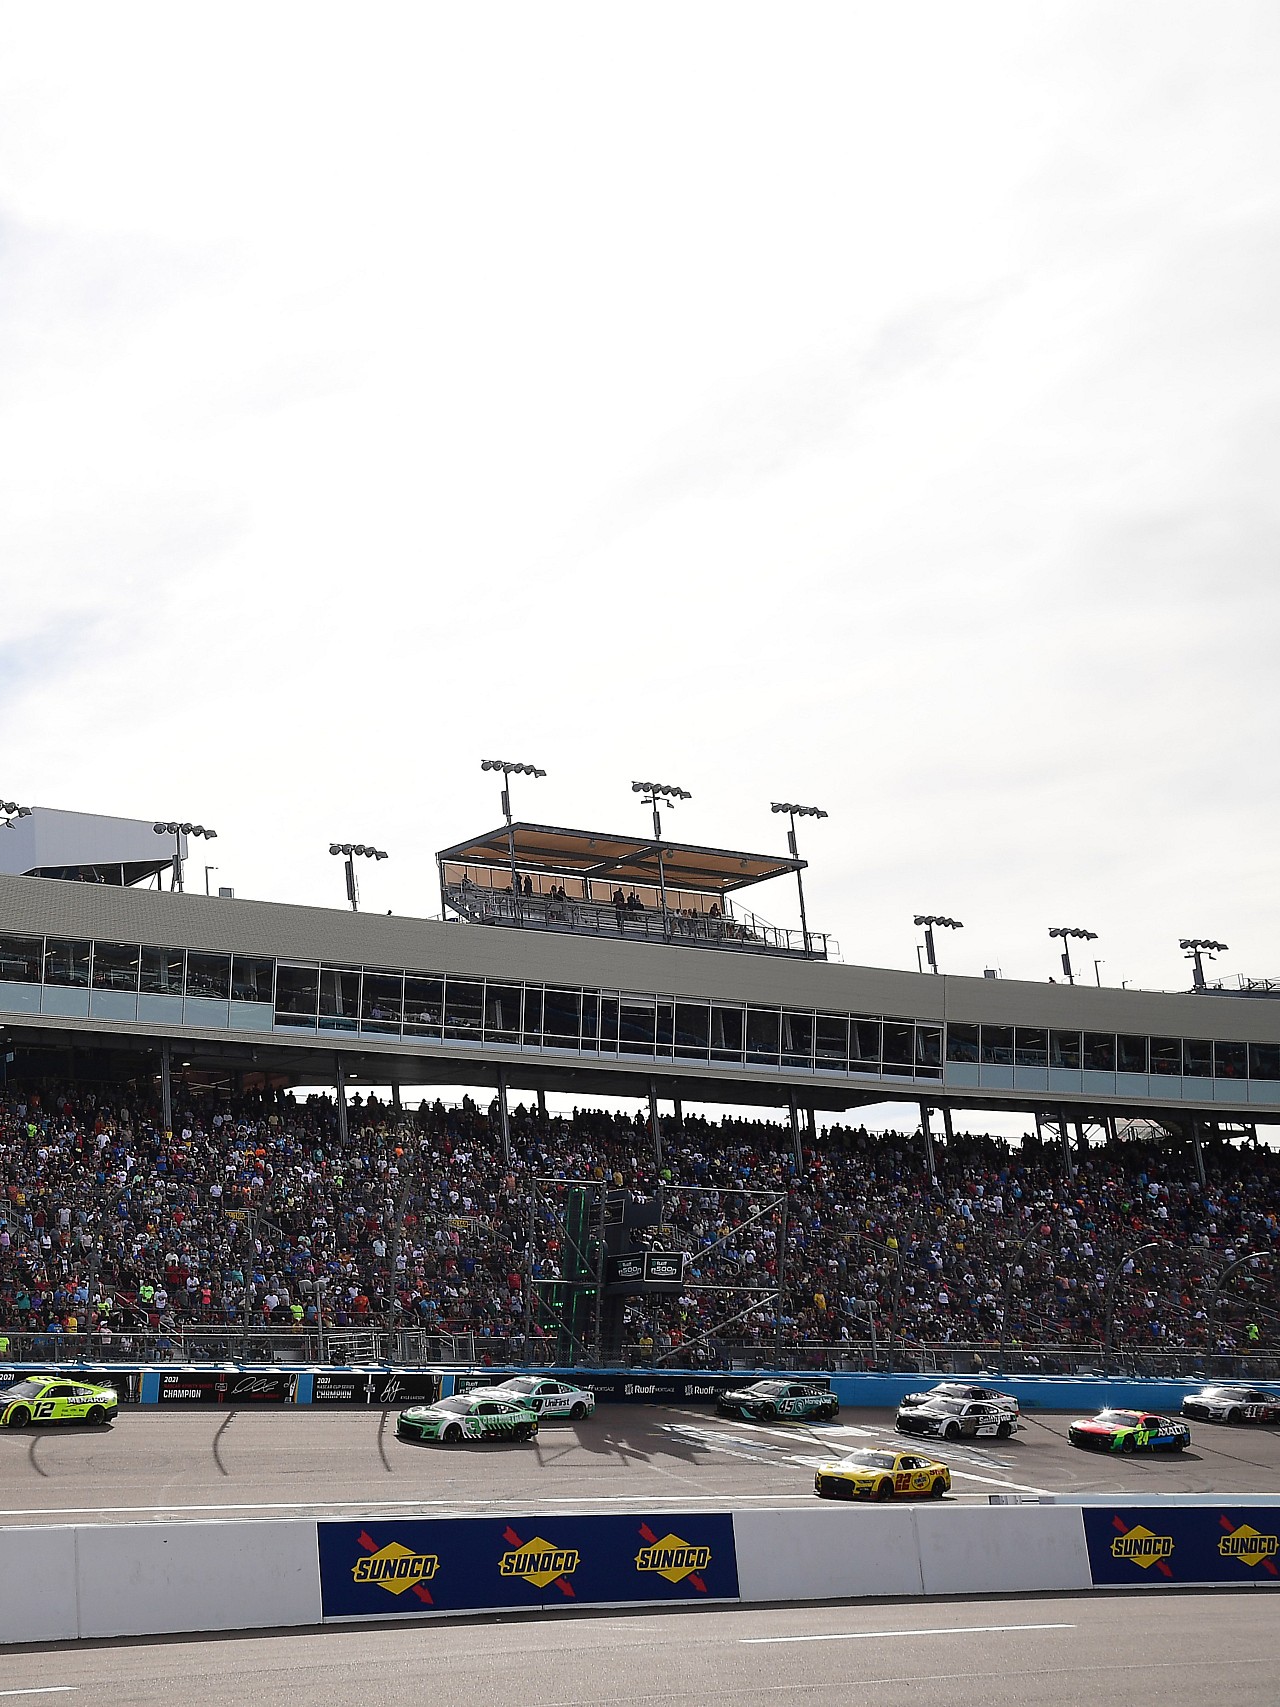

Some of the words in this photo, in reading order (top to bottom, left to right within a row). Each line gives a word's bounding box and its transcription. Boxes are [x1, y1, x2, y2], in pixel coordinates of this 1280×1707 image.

[163, 1389, 201, 1398] CHAMPION
[316, 1390, 352, 1399] CHAMPION
[634, 1385, 655, 1394] Ruoff
[694, 1386, 714, 1395] Ruoff
[33, 1401, 56, 1418] 12
[532, 1399, 544, 1412] 9
[779, 1400, 794, 1413] 45
[1244, 1405, 1257, 1418] 41
[465, 1417, 481, 1434] 3
[1137, 1431, 1149, 1446] 24
[895, 1473, 911, 1491] 22
[1114, 1538, 1171, 1556] SUNOCO
[1221, 1537, 1276, 1555] SUNOCO
[502, 1551, 578, 1574] SUNOCO
[639, 1546, 708, 1569] SUNOCO
[356, 1558, 437, 1580] SUNOCO
